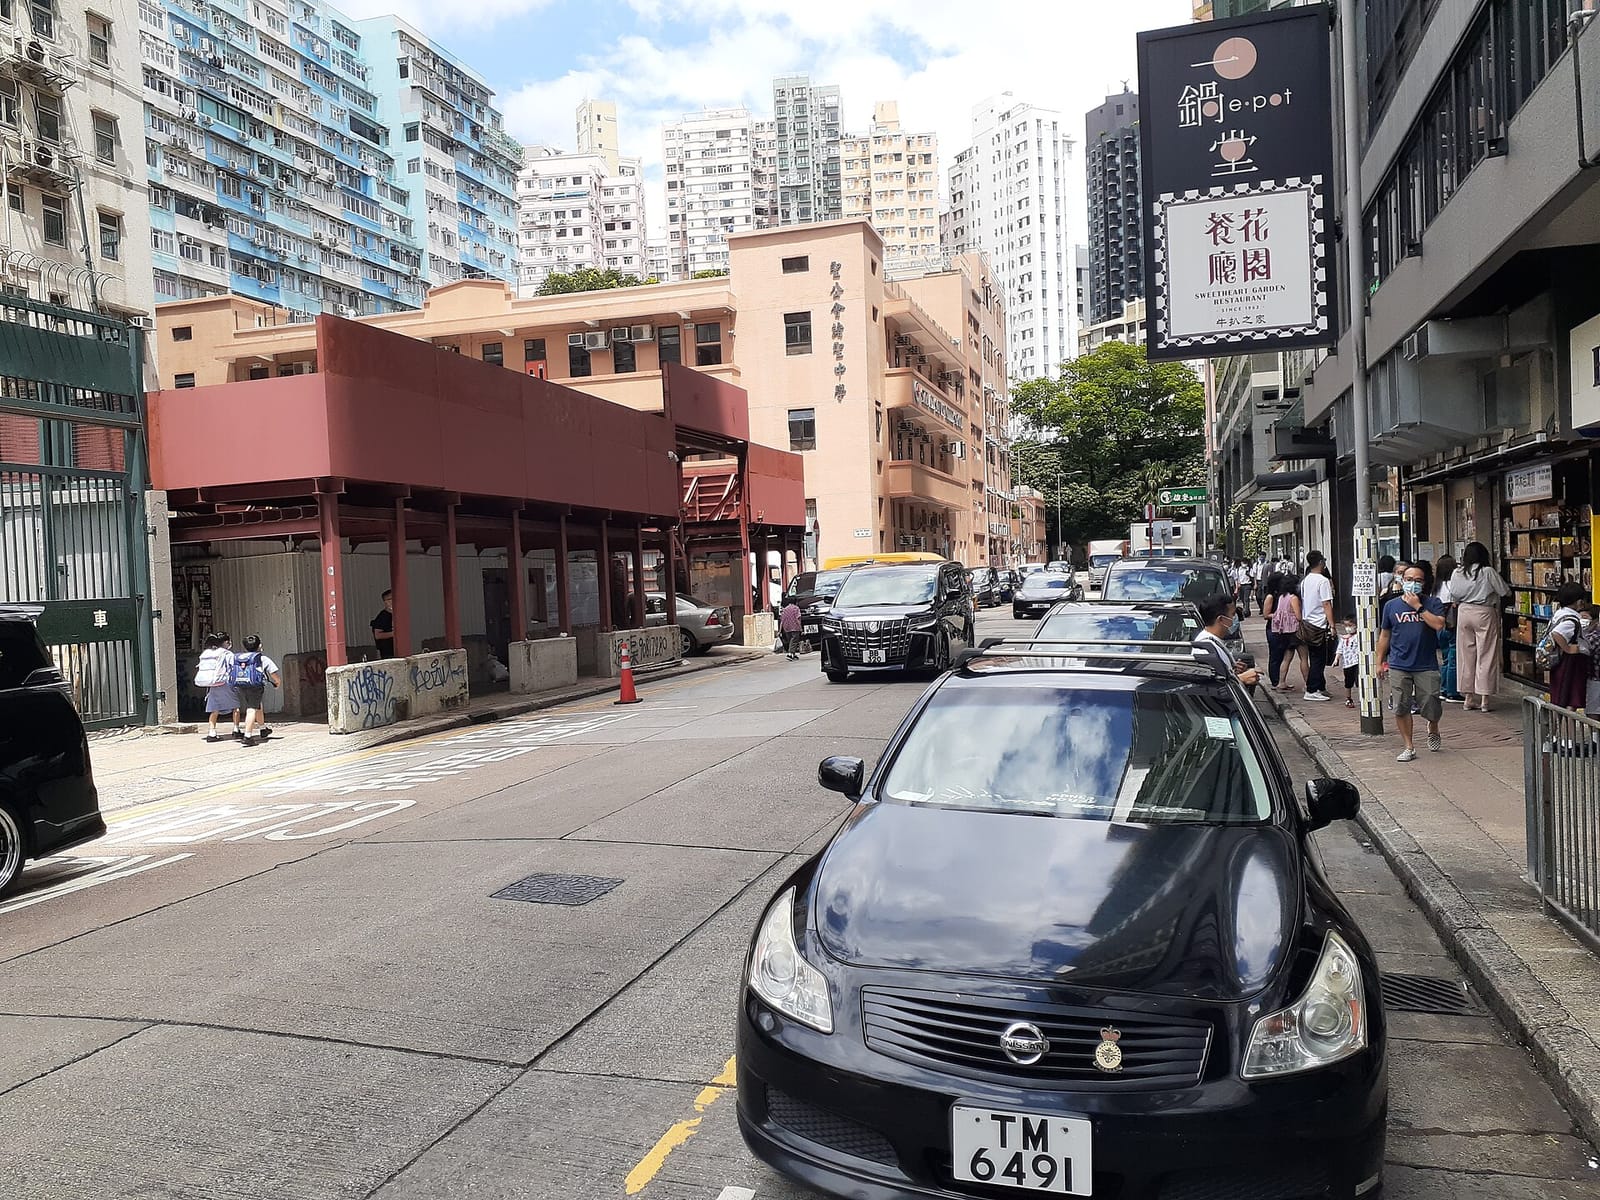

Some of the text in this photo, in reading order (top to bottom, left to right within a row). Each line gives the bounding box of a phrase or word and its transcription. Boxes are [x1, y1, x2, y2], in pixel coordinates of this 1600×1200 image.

[1194, 284, 1286, 300] SWEETHEART GARDEN
[1213, 294, 1267, 306] RESTAURANT
[1216, 314, 1267, 328] 牛扒之家
[93, 609, 107, 628] 車
[1005, 1040, 1045, 1051] NISSAN
[990, 1113, 1049, 1153] TM
[970, 1147, 1073, 1192] 6491
